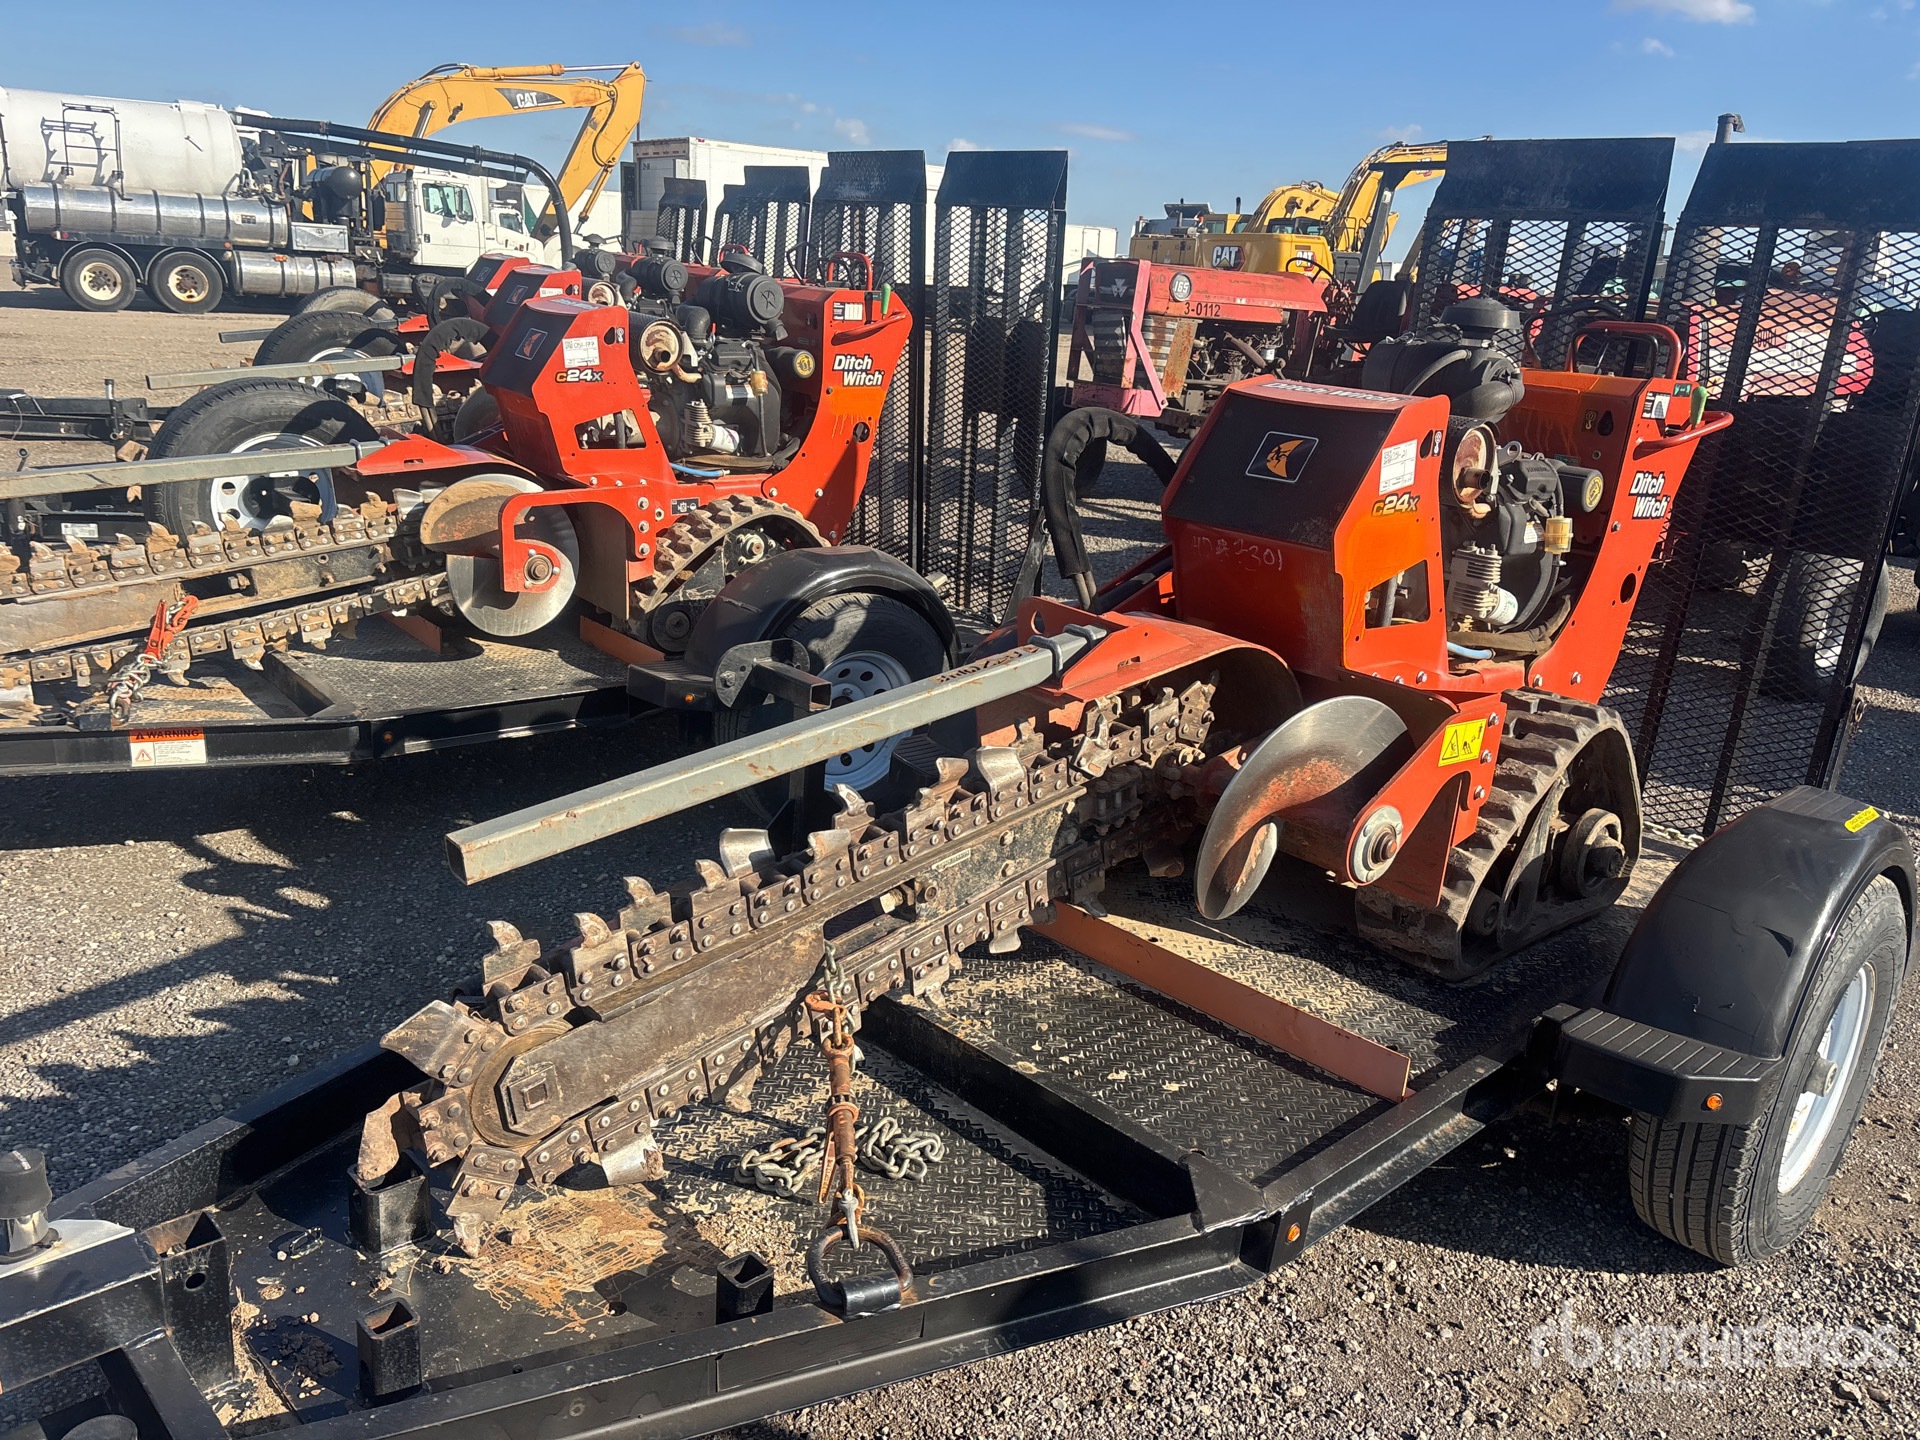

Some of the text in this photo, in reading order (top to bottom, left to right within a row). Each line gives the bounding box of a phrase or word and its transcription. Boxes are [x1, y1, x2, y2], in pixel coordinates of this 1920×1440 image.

[515, 91, 538, 108] CAT
[1212, 245, 1238, 267] CAT
[1173, 280, 1190, 293] 165
[1184, 301, 1221, 317] 3-0112
[832, 353, 873, 371] Ditch
[843, 370, 885, 387] Witch
[1628, 470, 1665, 496] Ditch
[1632, 494, 1671, 519] Witch
[146, 729, 200, 739] WARNING
